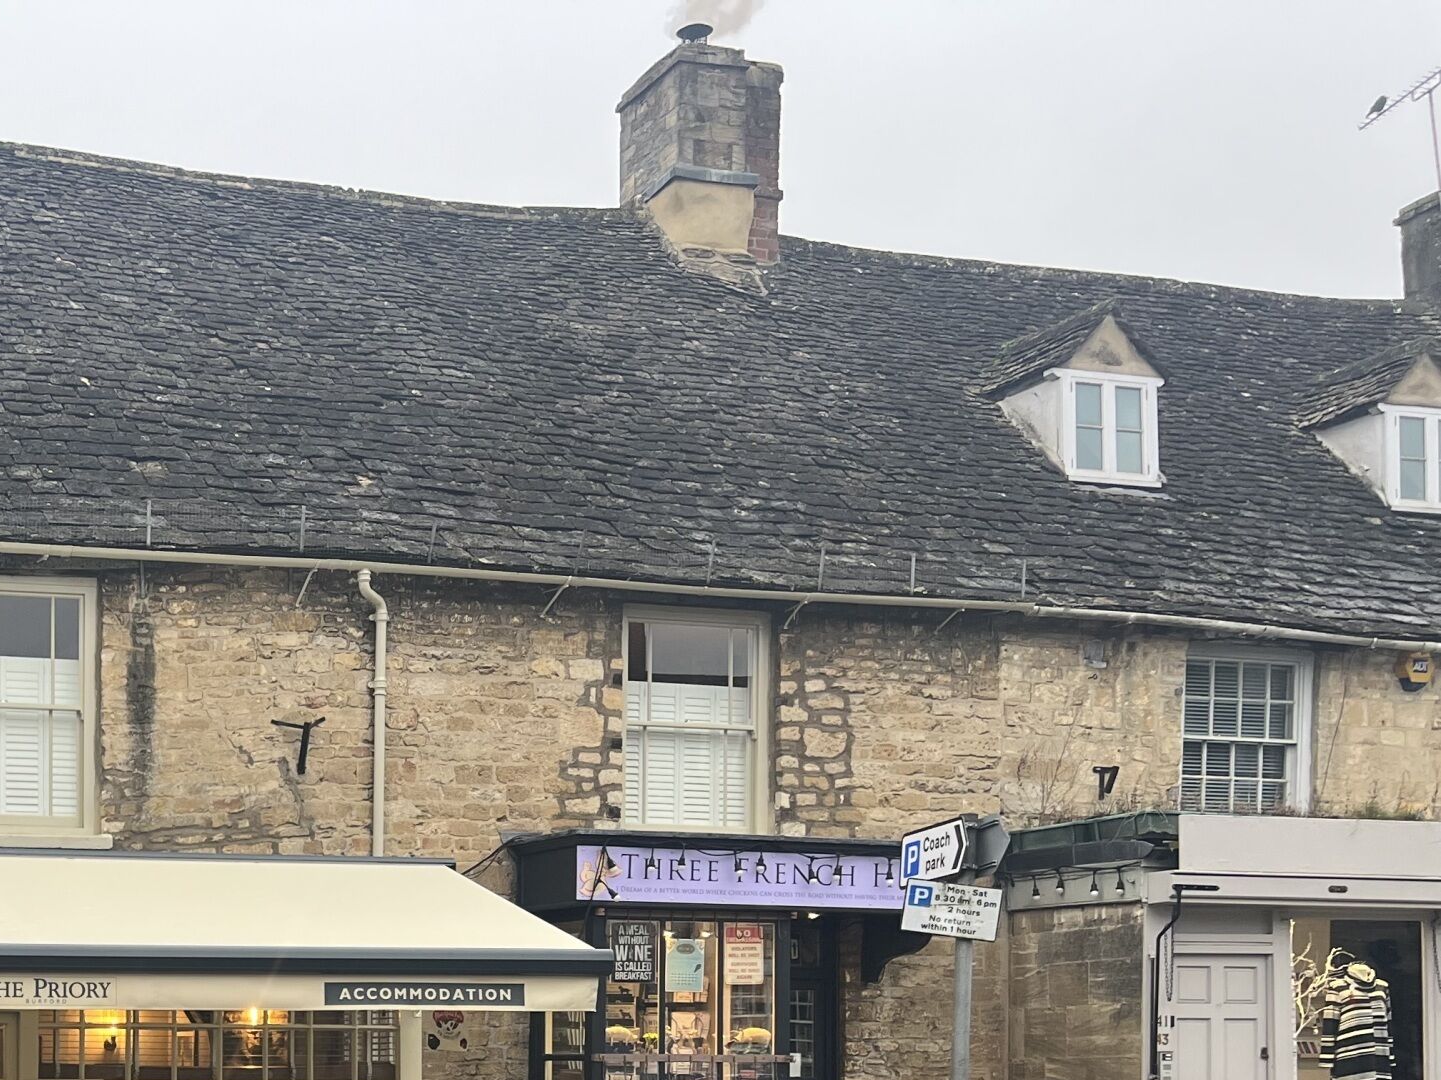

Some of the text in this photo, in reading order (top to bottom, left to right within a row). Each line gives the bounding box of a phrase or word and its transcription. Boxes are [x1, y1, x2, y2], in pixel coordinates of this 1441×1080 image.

[923, 832, 950, 852] Coach
[907, 845, 919, 875] P
[925, 853, 945, 874] park
[621, 854, 719, 881] THREE
[737, 858, 856, 886] FRENCH
[914, 888, 929, 905] P
[947, 886, 966, 895] Mon
[972, 889, 988, 897] Sat
[947, 906, 981, 917] 2 hours
[929, 914, 971, 926] No return
[618, 924, 649, 935] A MEAL
[921, 923, 947, 932] within
[956, 927, 977, 935] hour
[618, 936, 650, 945] WITHOUT
[615, 961, 652, 971] IS CALLED
[615, 971, 653, 980] BREAKFAST
[33, 978, 111, 998] PRIORY
[339, 987, 512, 1001] ACCOMMODATION
